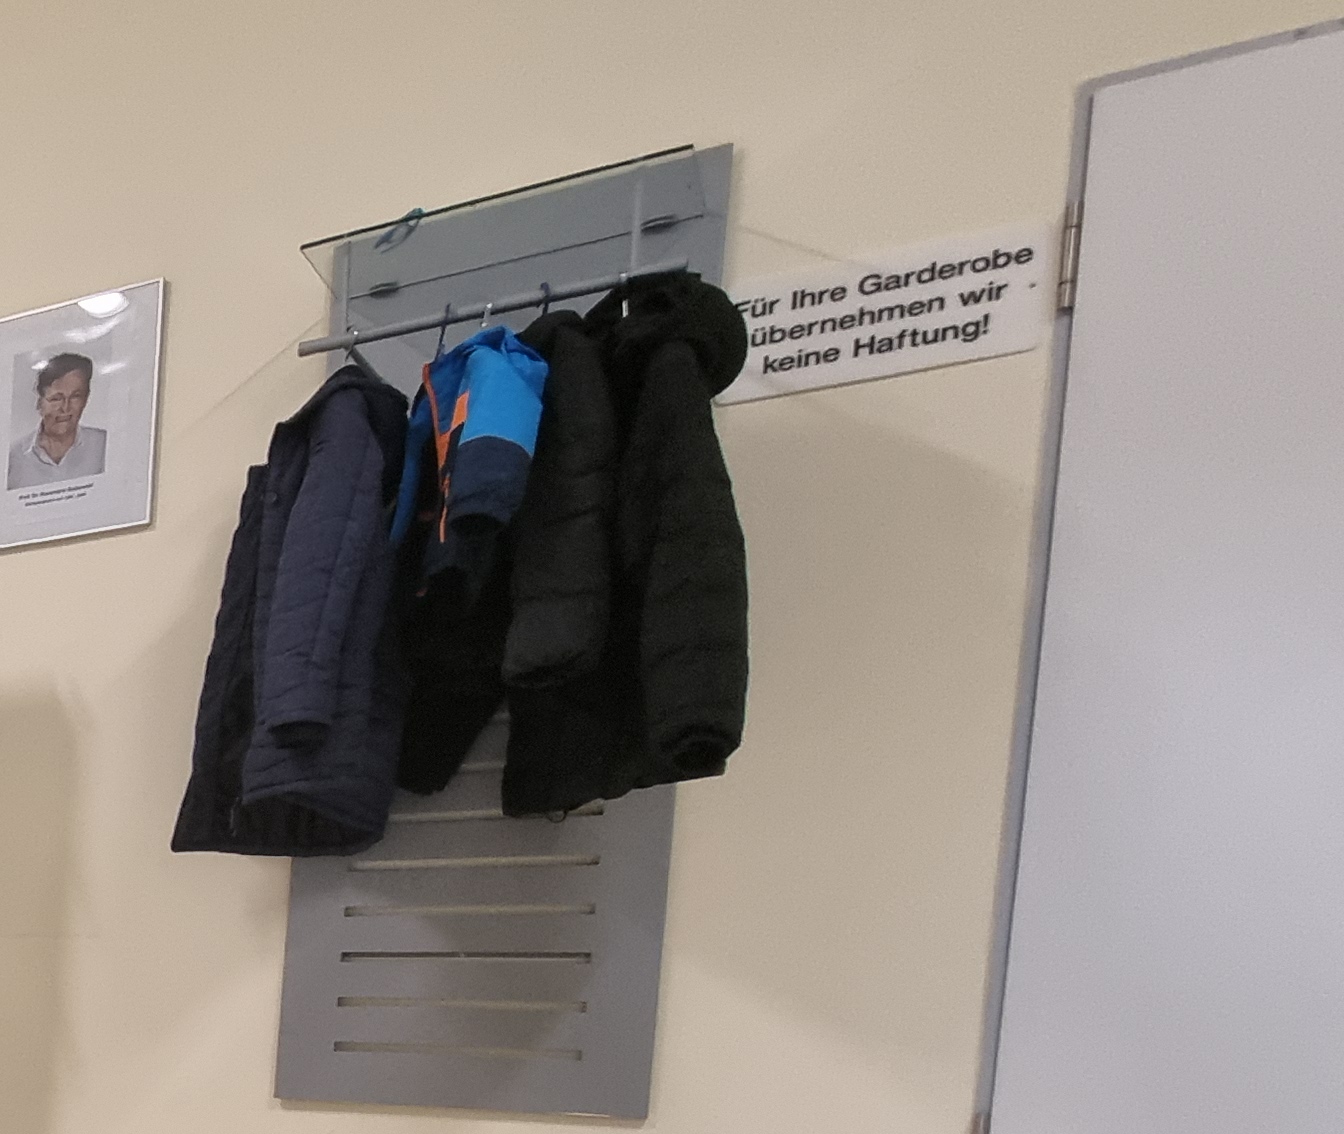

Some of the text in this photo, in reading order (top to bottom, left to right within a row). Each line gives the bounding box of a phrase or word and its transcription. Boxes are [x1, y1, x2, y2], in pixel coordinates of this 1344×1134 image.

[735, 246, 1034, 318] Für Ihre Garderobe
[751, 280, 1009, 348] übernehmen wir
[762, 314, 991, 375] keine Haftung!
